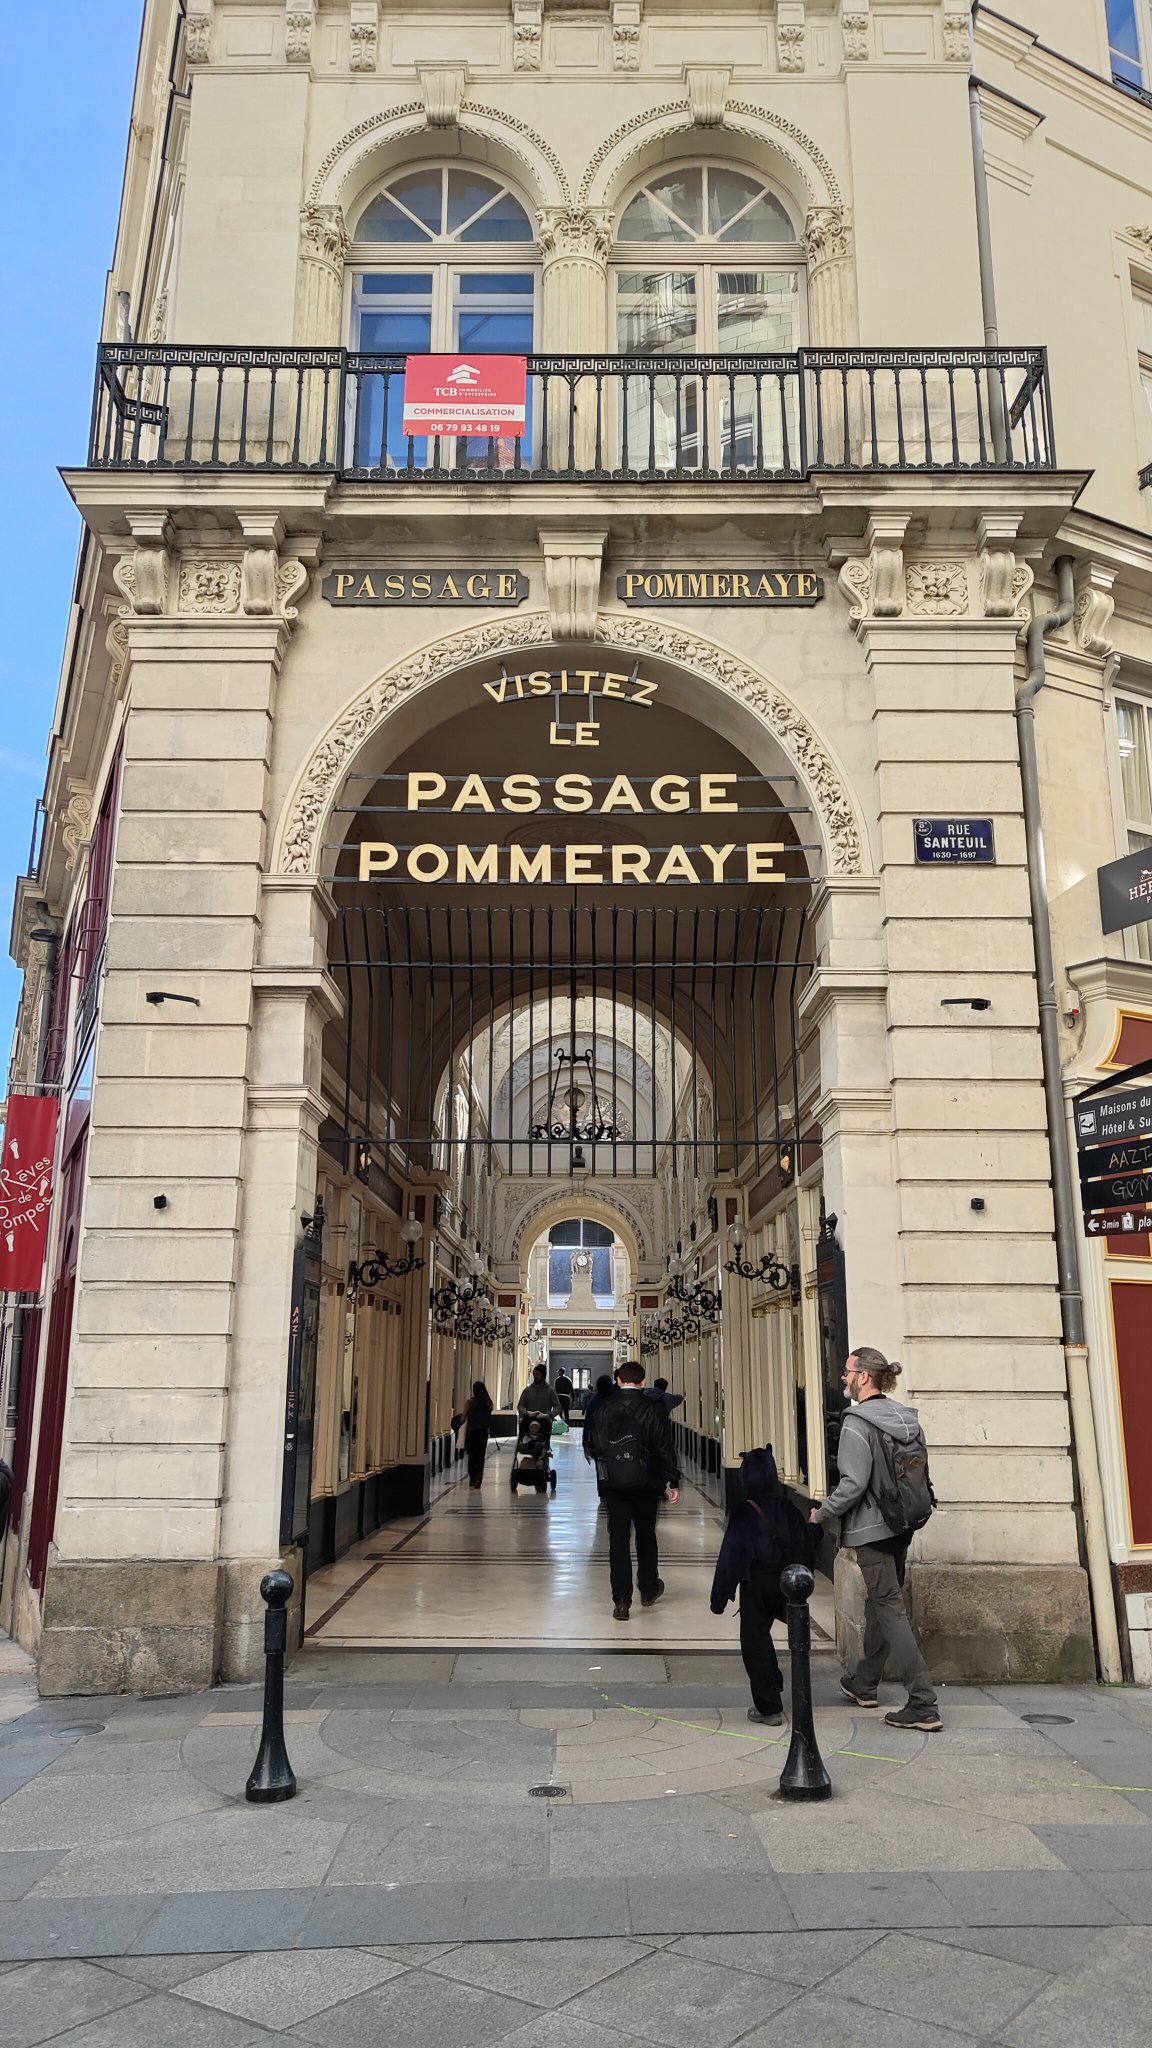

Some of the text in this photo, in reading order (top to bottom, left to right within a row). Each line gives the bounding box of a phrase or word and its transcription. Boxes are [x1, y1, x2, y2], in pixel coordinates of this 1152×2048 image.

[433, 387, 458, 397] TCB
[413, 408, 515, 416] COMMERCIALISATION
[430, 423, 501, 432] 06 79 93 48 19
[333, 573, 820, 599] PASSAGE POMMERAYE
[482, 669, 659, 707] VISITEZ
[549, 721, 600, 746] LE
[407, 771, 739, 813] PASSAGE
[947, 824, 971, 835] RUE
[924, 837, 987, 849] SANTEUIL
[932, 851, 952, 859] 1630
[960, 851, 977, 859] 1697
[358, 841, 786, 884] POMMERAYE
[1100, 1095, 1151, 1117] Maisons du
[1101, 1120, 1126, 1136] Hôtel
[1128, 1119, 1136, 1130] &
[18, 1190, 32, 1204] de
[1101, 1219, 1120, 1230] 3min
